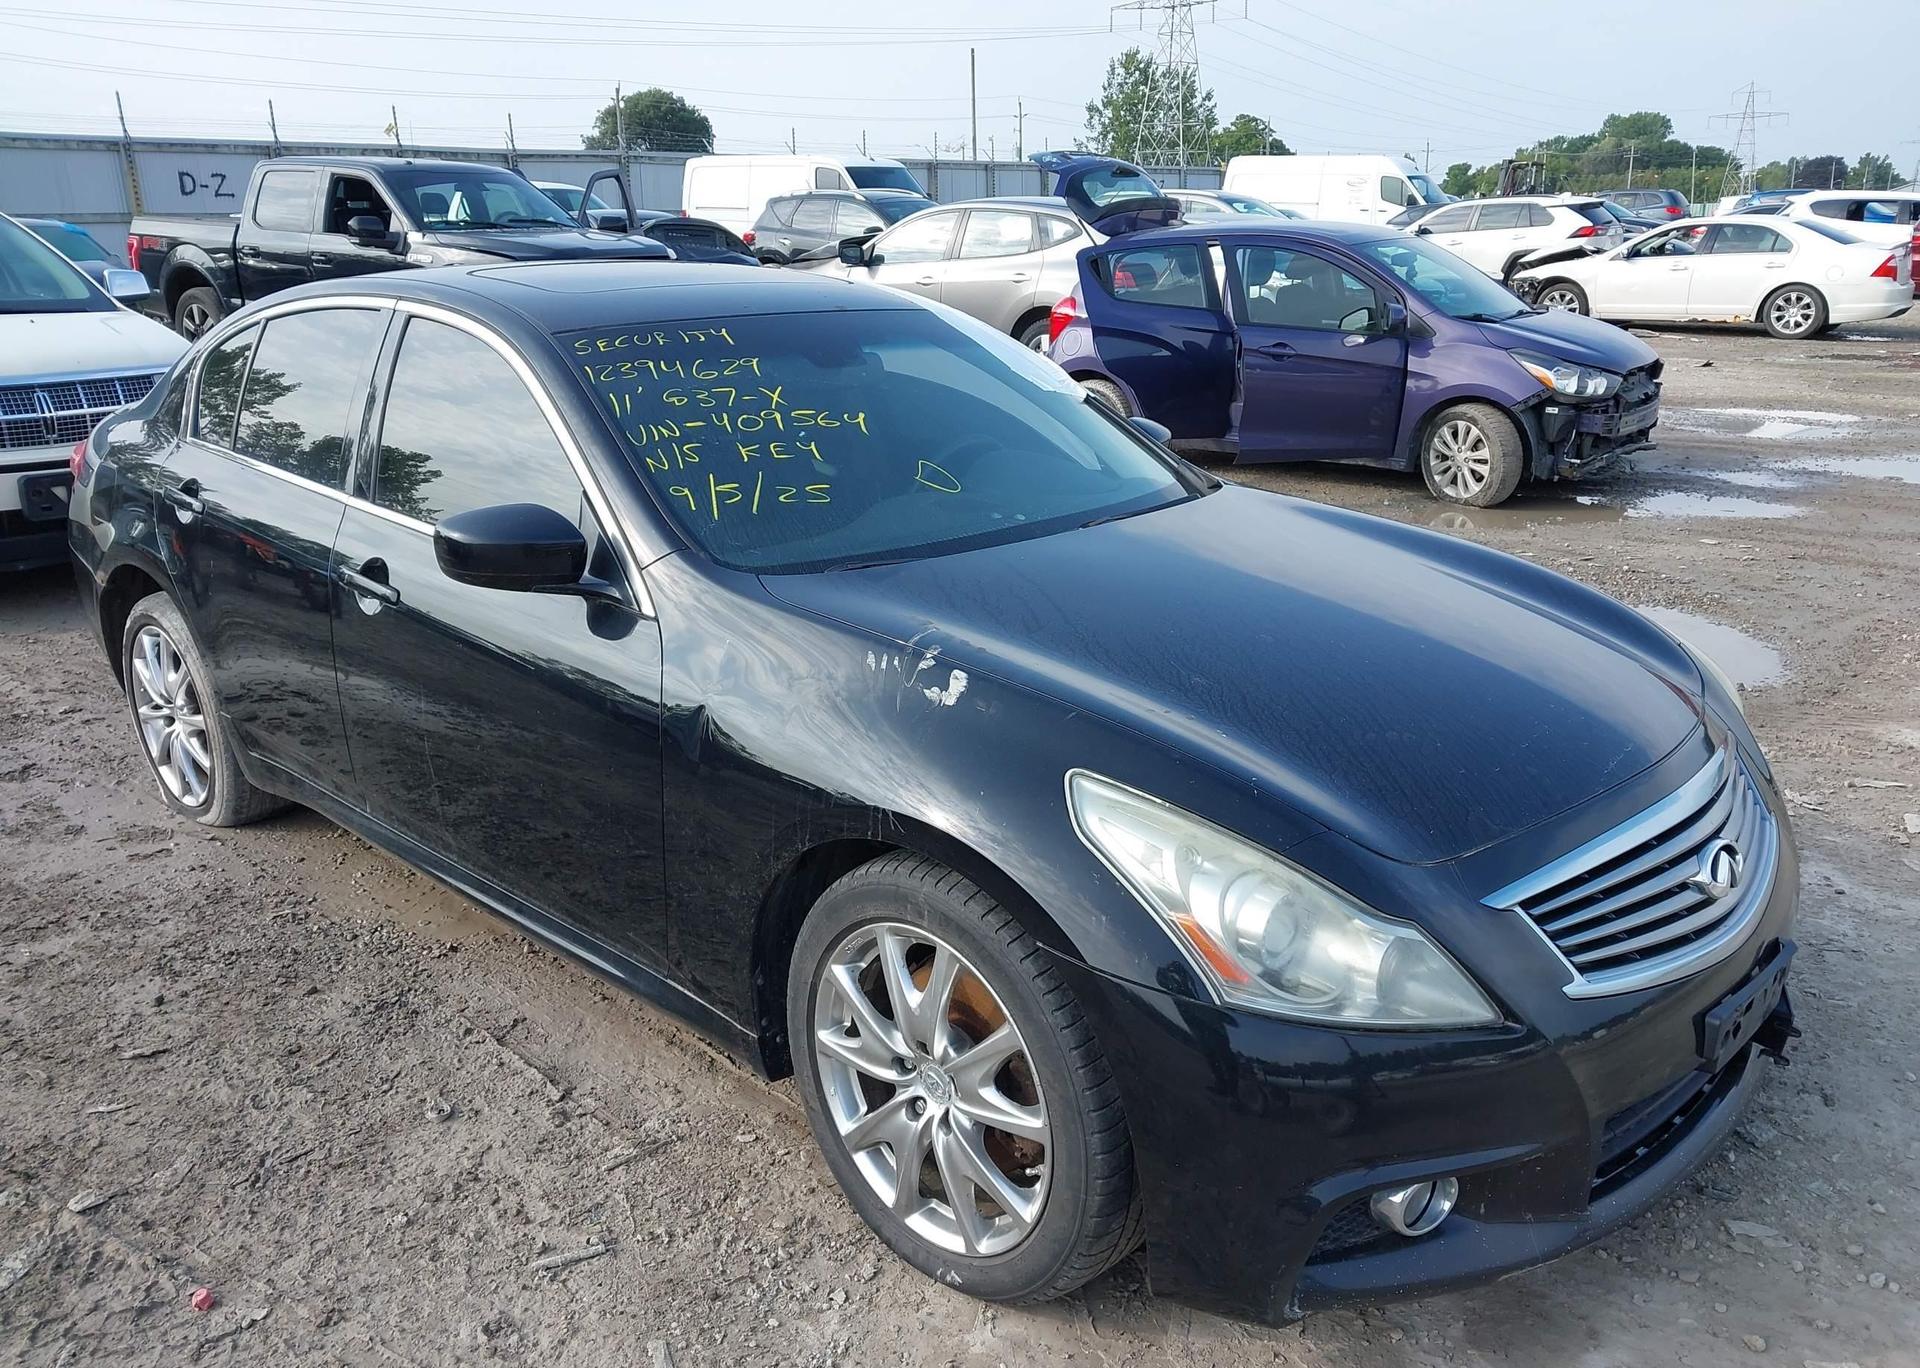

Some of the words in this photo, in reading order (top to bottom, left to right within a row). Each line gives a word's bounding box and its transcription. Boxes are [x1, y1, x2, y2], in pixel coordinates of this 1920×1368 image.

[574, 327, 735, 355] SECURITY
[584, 357, 761, 385] 12394629
[736, 441, 824, 462] KEY
